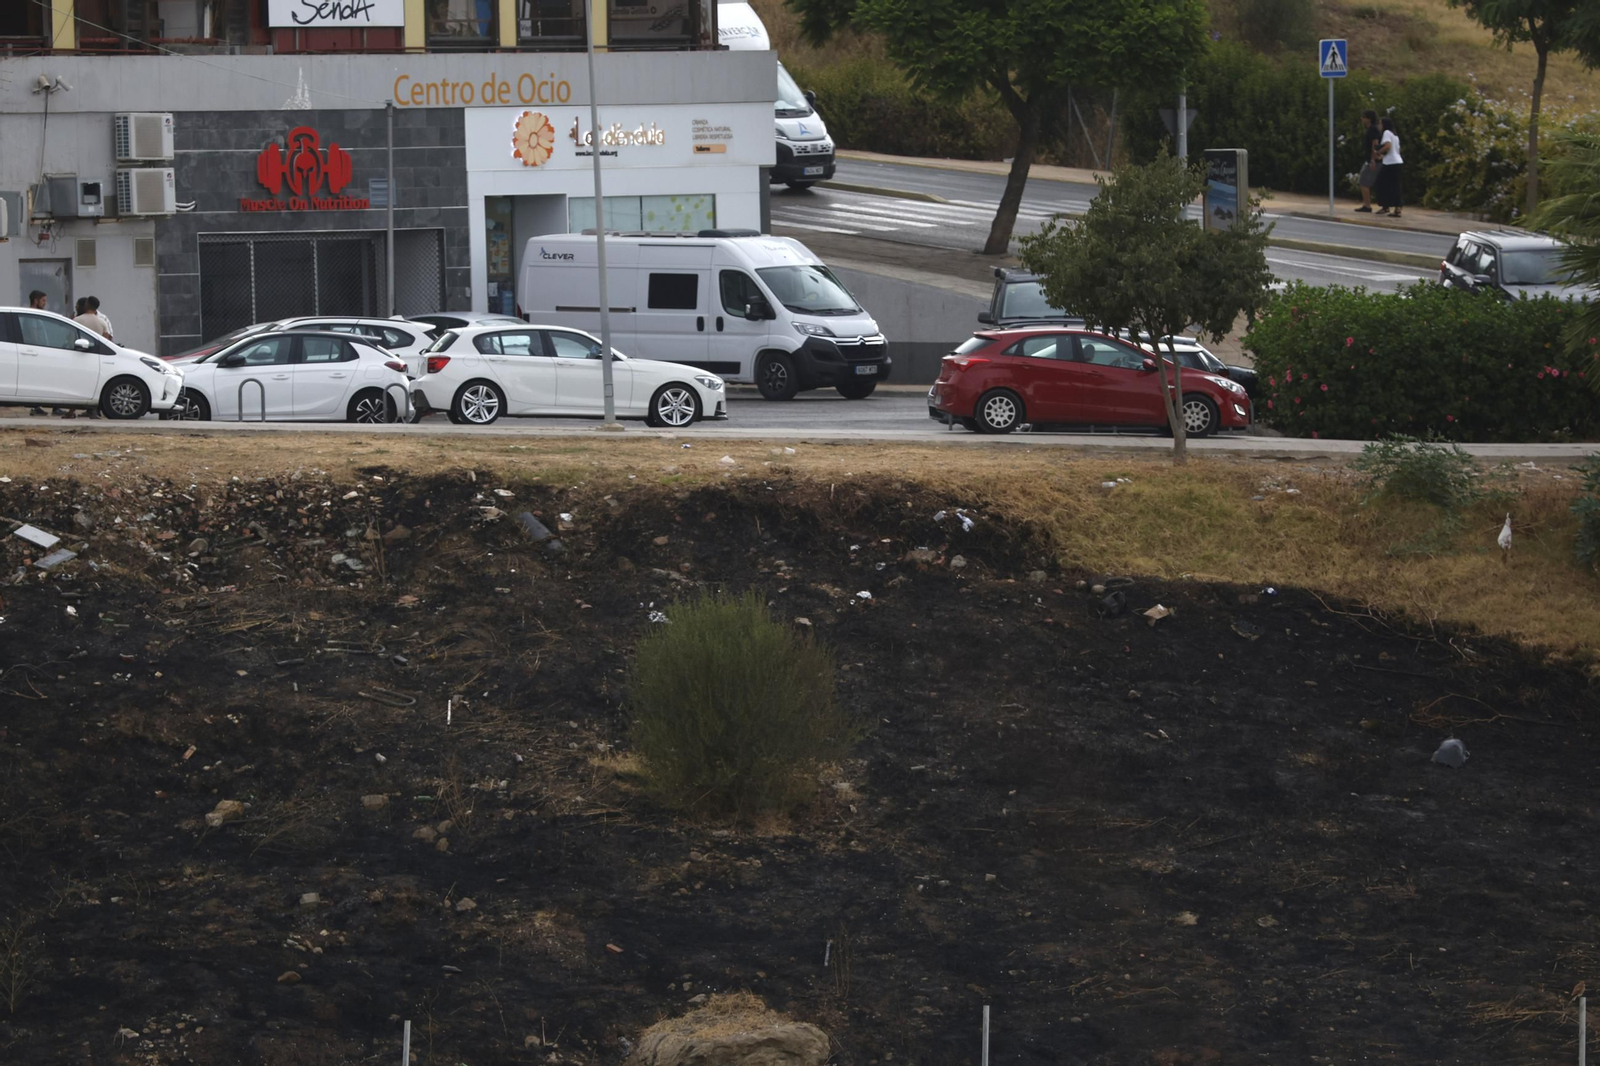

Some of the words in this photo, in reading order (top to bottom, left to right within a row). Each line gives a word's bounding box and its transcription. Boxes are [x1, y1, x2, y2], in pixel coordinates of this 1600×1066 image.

[394, 74, 475, 106] Centro
[481, 72, 511, 104] de
[517, 72, 571, 104] Ocio
[240, 197, 286, 212] Muscle
[289, 196, 308, 210] On
[310, 195, 370, 210] Nutrition
